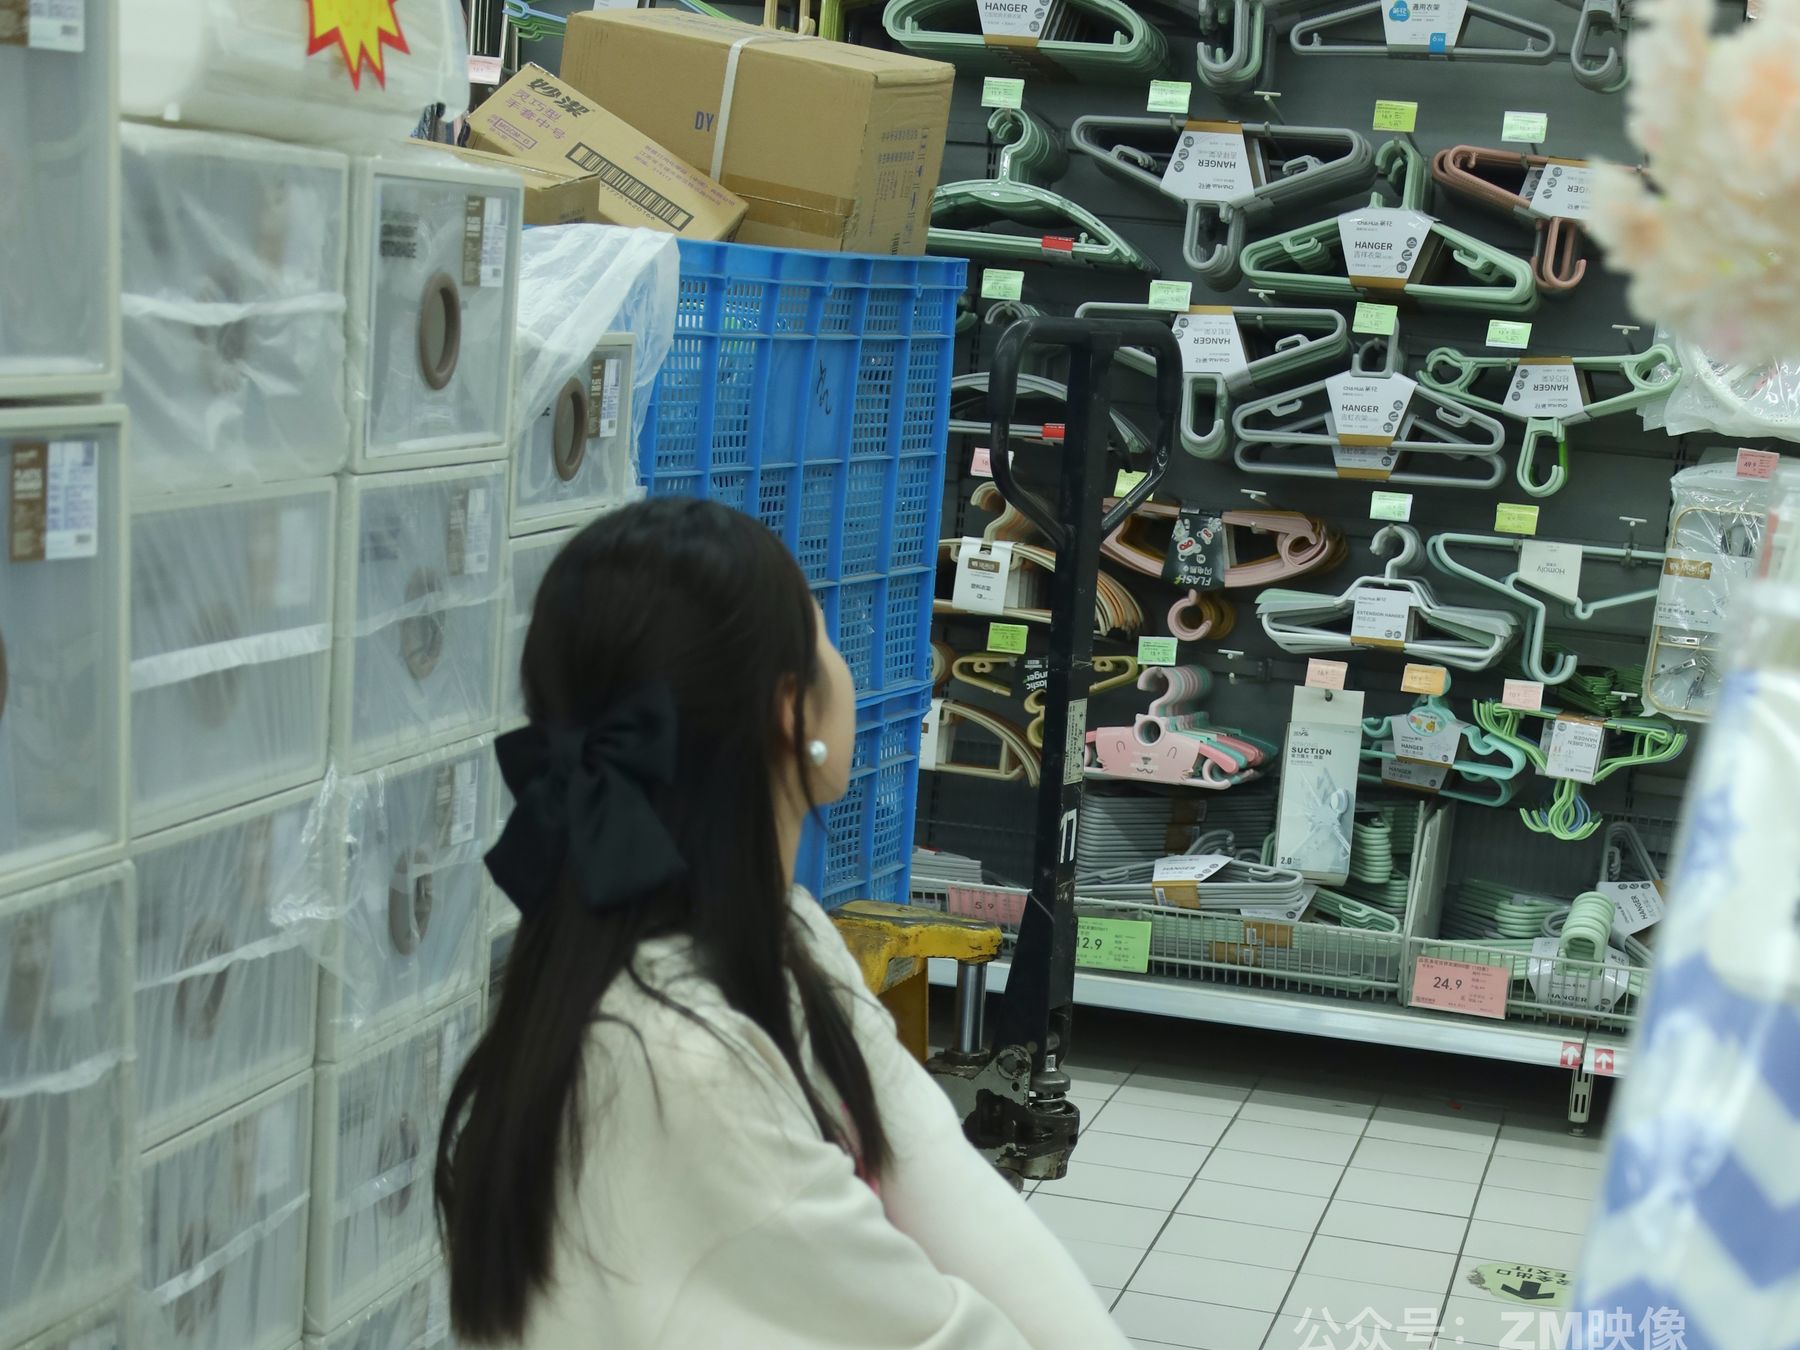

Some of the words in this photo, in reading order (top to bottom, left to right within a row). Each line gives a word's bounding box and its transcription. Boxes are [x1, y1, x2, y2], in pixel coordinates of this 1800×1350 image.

[985, 3, 1028, 13] HANGER
[695, 111, 714, 132] DY
[1198, 159, 1236, 169] HANGER
[1354, 241, 1393, 251] HANGER
[1193, 336, 1231, 345] HANGER
[1533, 383, 1569, 392] HANGER
[1341, 404, 1379, 413] HANGER
[1536, 565, 1566, 575] Homoly
[1177, 574, 1213, 587] FLASH
[1027, 670, 1048, 682] nger
[1026, 680, 1048, 692] lastic
[1291, 747, 1332, 756] SUCTION
[1401, 743, 1424, 751] HANGER
[1281, 856, 1292, 865] 2.0
[1631, 895, 1647, 920] HANGER
[1433, 976, 1463, 991] 24.9
[1547, 993, 1587, 1002] HANGER
[1511, 1265, 1567, 1279] EXIT
